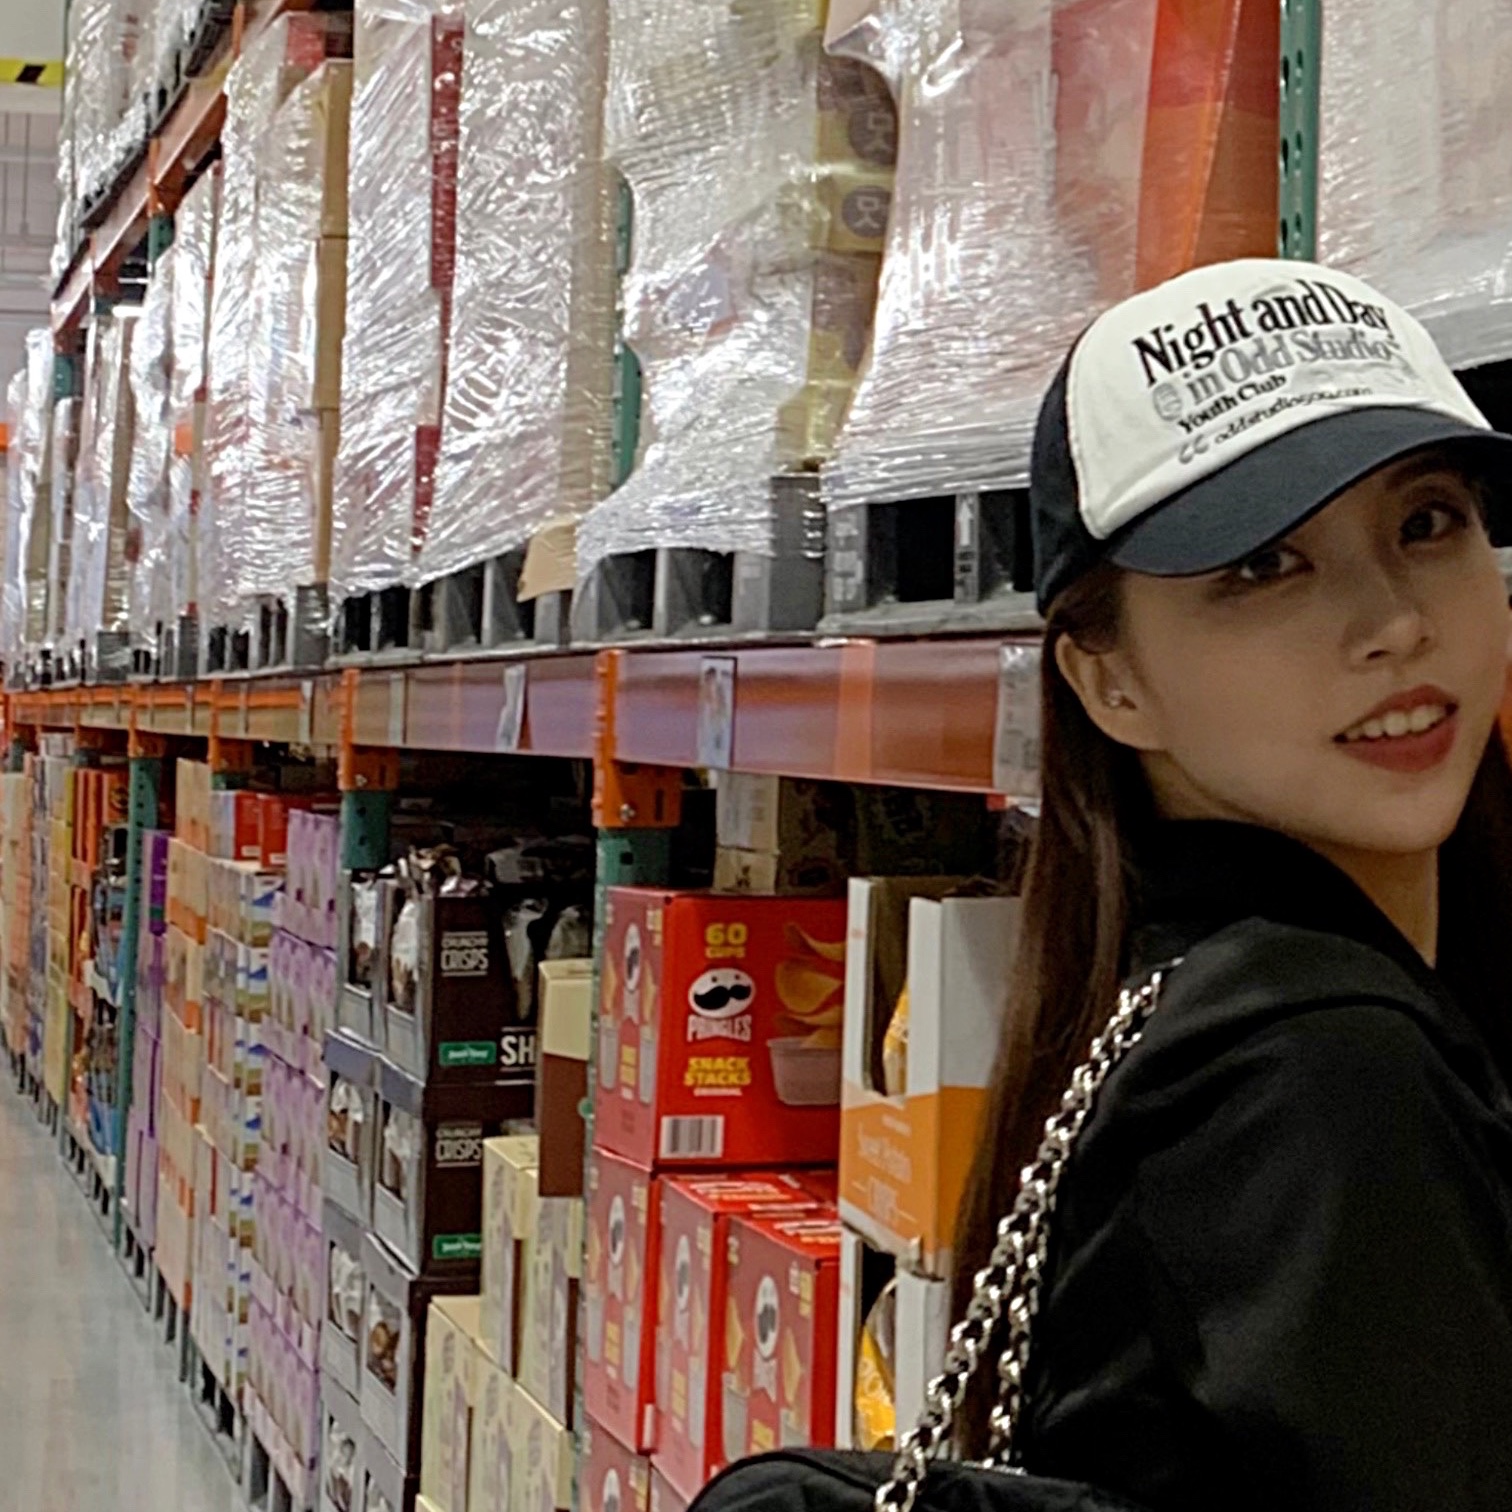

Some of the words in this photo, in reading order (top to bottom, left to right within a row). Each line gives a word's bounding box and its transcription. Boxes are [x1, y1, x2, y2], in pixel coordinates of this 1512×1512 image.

[1131, 298, 1253, 388] Night
[1251, 278, 1334, 333] and
[1184, 370, 1226, 406] in
[1218, 333, 1296, 385] Odd
[1290, 326, 1394, 364] Studio
[1177, 391, 1240, 435] Youth
[1236, 374, 1288, 402] Club
[705, 922, 748, 946] 60
[440, 948, 489, 971] CRISPS
[687, 1056, 751, 1072] SNACK
[683, 1070, 751, 1087] STACKS
